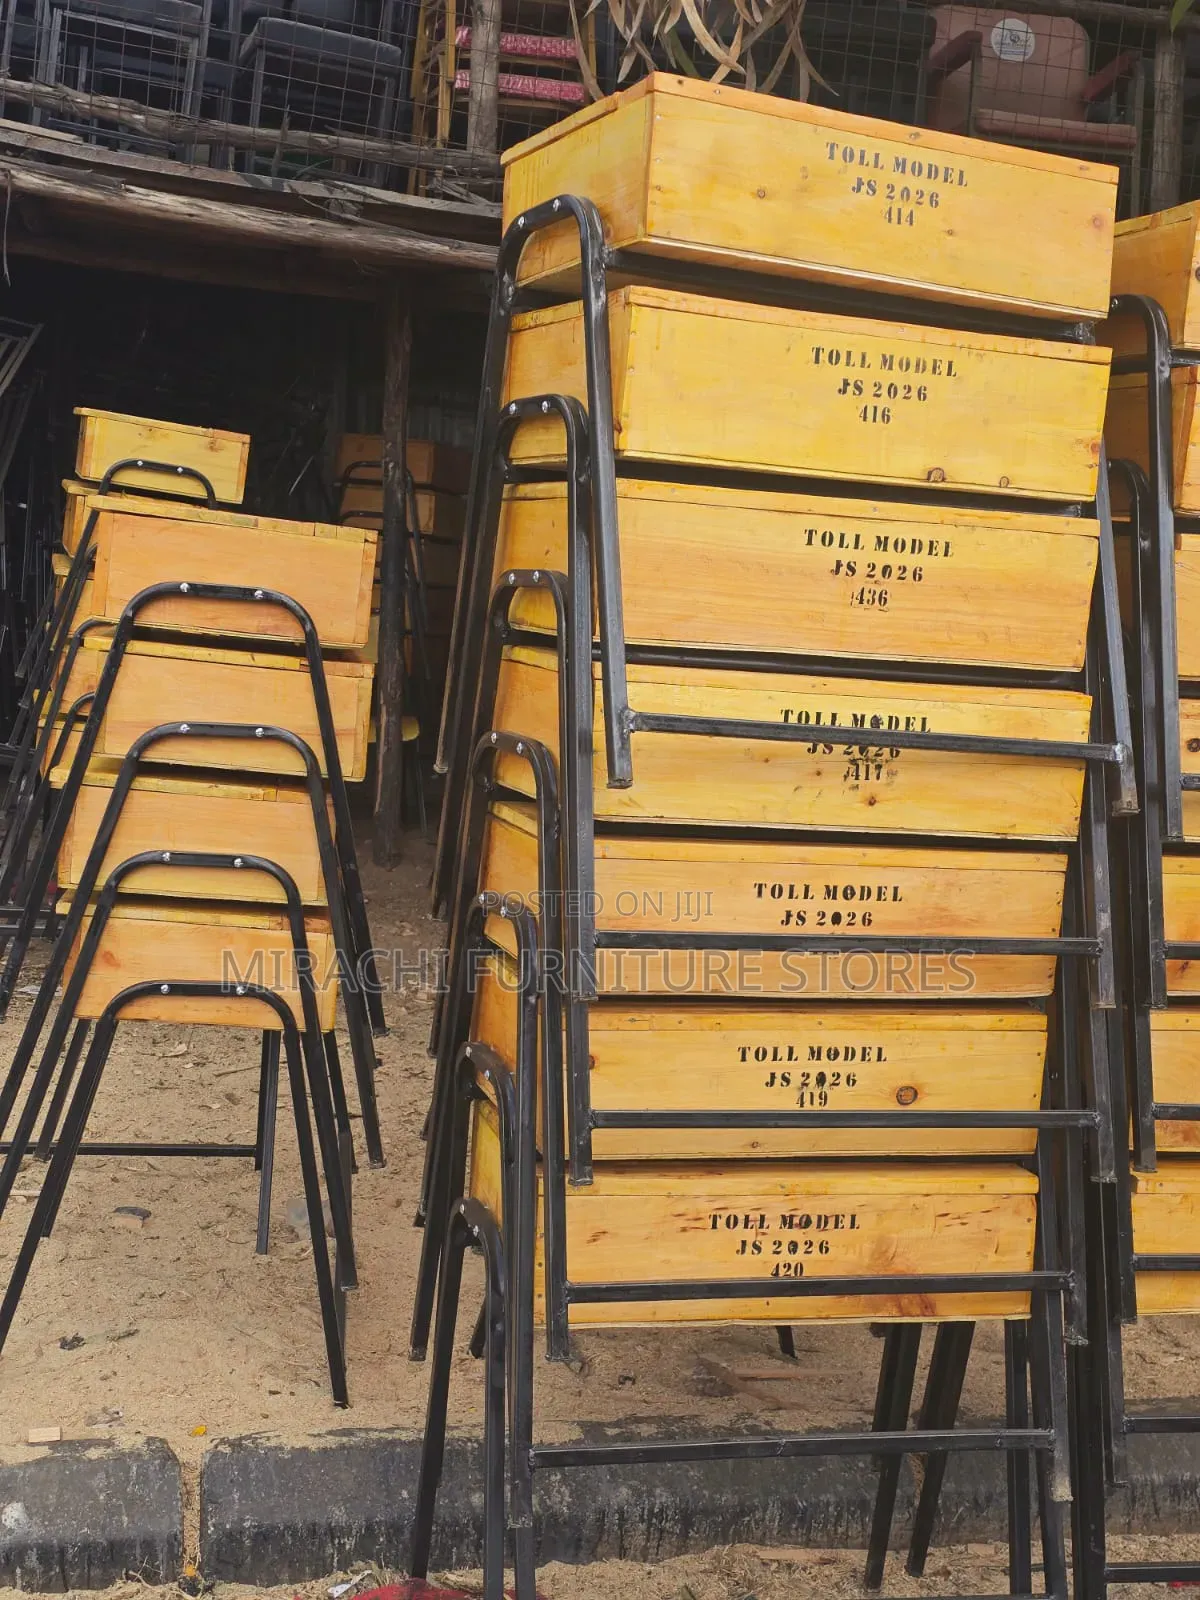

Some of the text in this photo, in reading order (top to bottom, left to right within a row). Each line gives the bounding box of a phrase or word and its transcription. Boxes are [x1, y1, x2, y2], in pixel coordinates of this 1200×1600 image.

[826, 142, 968, 187] TOLL MODEL
[852, 176, 940, 208] JS 2026
[884, 206, 915, 226] 414
[811, 346, 957, 377] TOLL MODEL
[837, 379, 927, 402] JS 2026
[859, 405, 891, 424] 416
[804, 529, 954, 557] TOLL MODEL
[831, 559, 923, 582] JS 2026
[855, 587, 888, 607] 436
[780, 709, 931, 733] TOLL MODEL
[851, 762, 882, 781] 417
[754, 883, 903, 902] TOLL MODEL
[781, 910, 873, 927] JS 2026
[738, 1046, 887, 1062] TOLL MODEL
[765, 1072, 857, 1087] JS 2026
[796, 1091, 828, 1107] 419
[709, 1214, 860, 1229] TOLL MODEL
[736, 1240, 829, 1255] JS 2026
[771, 1262, 804, 1276] 420
